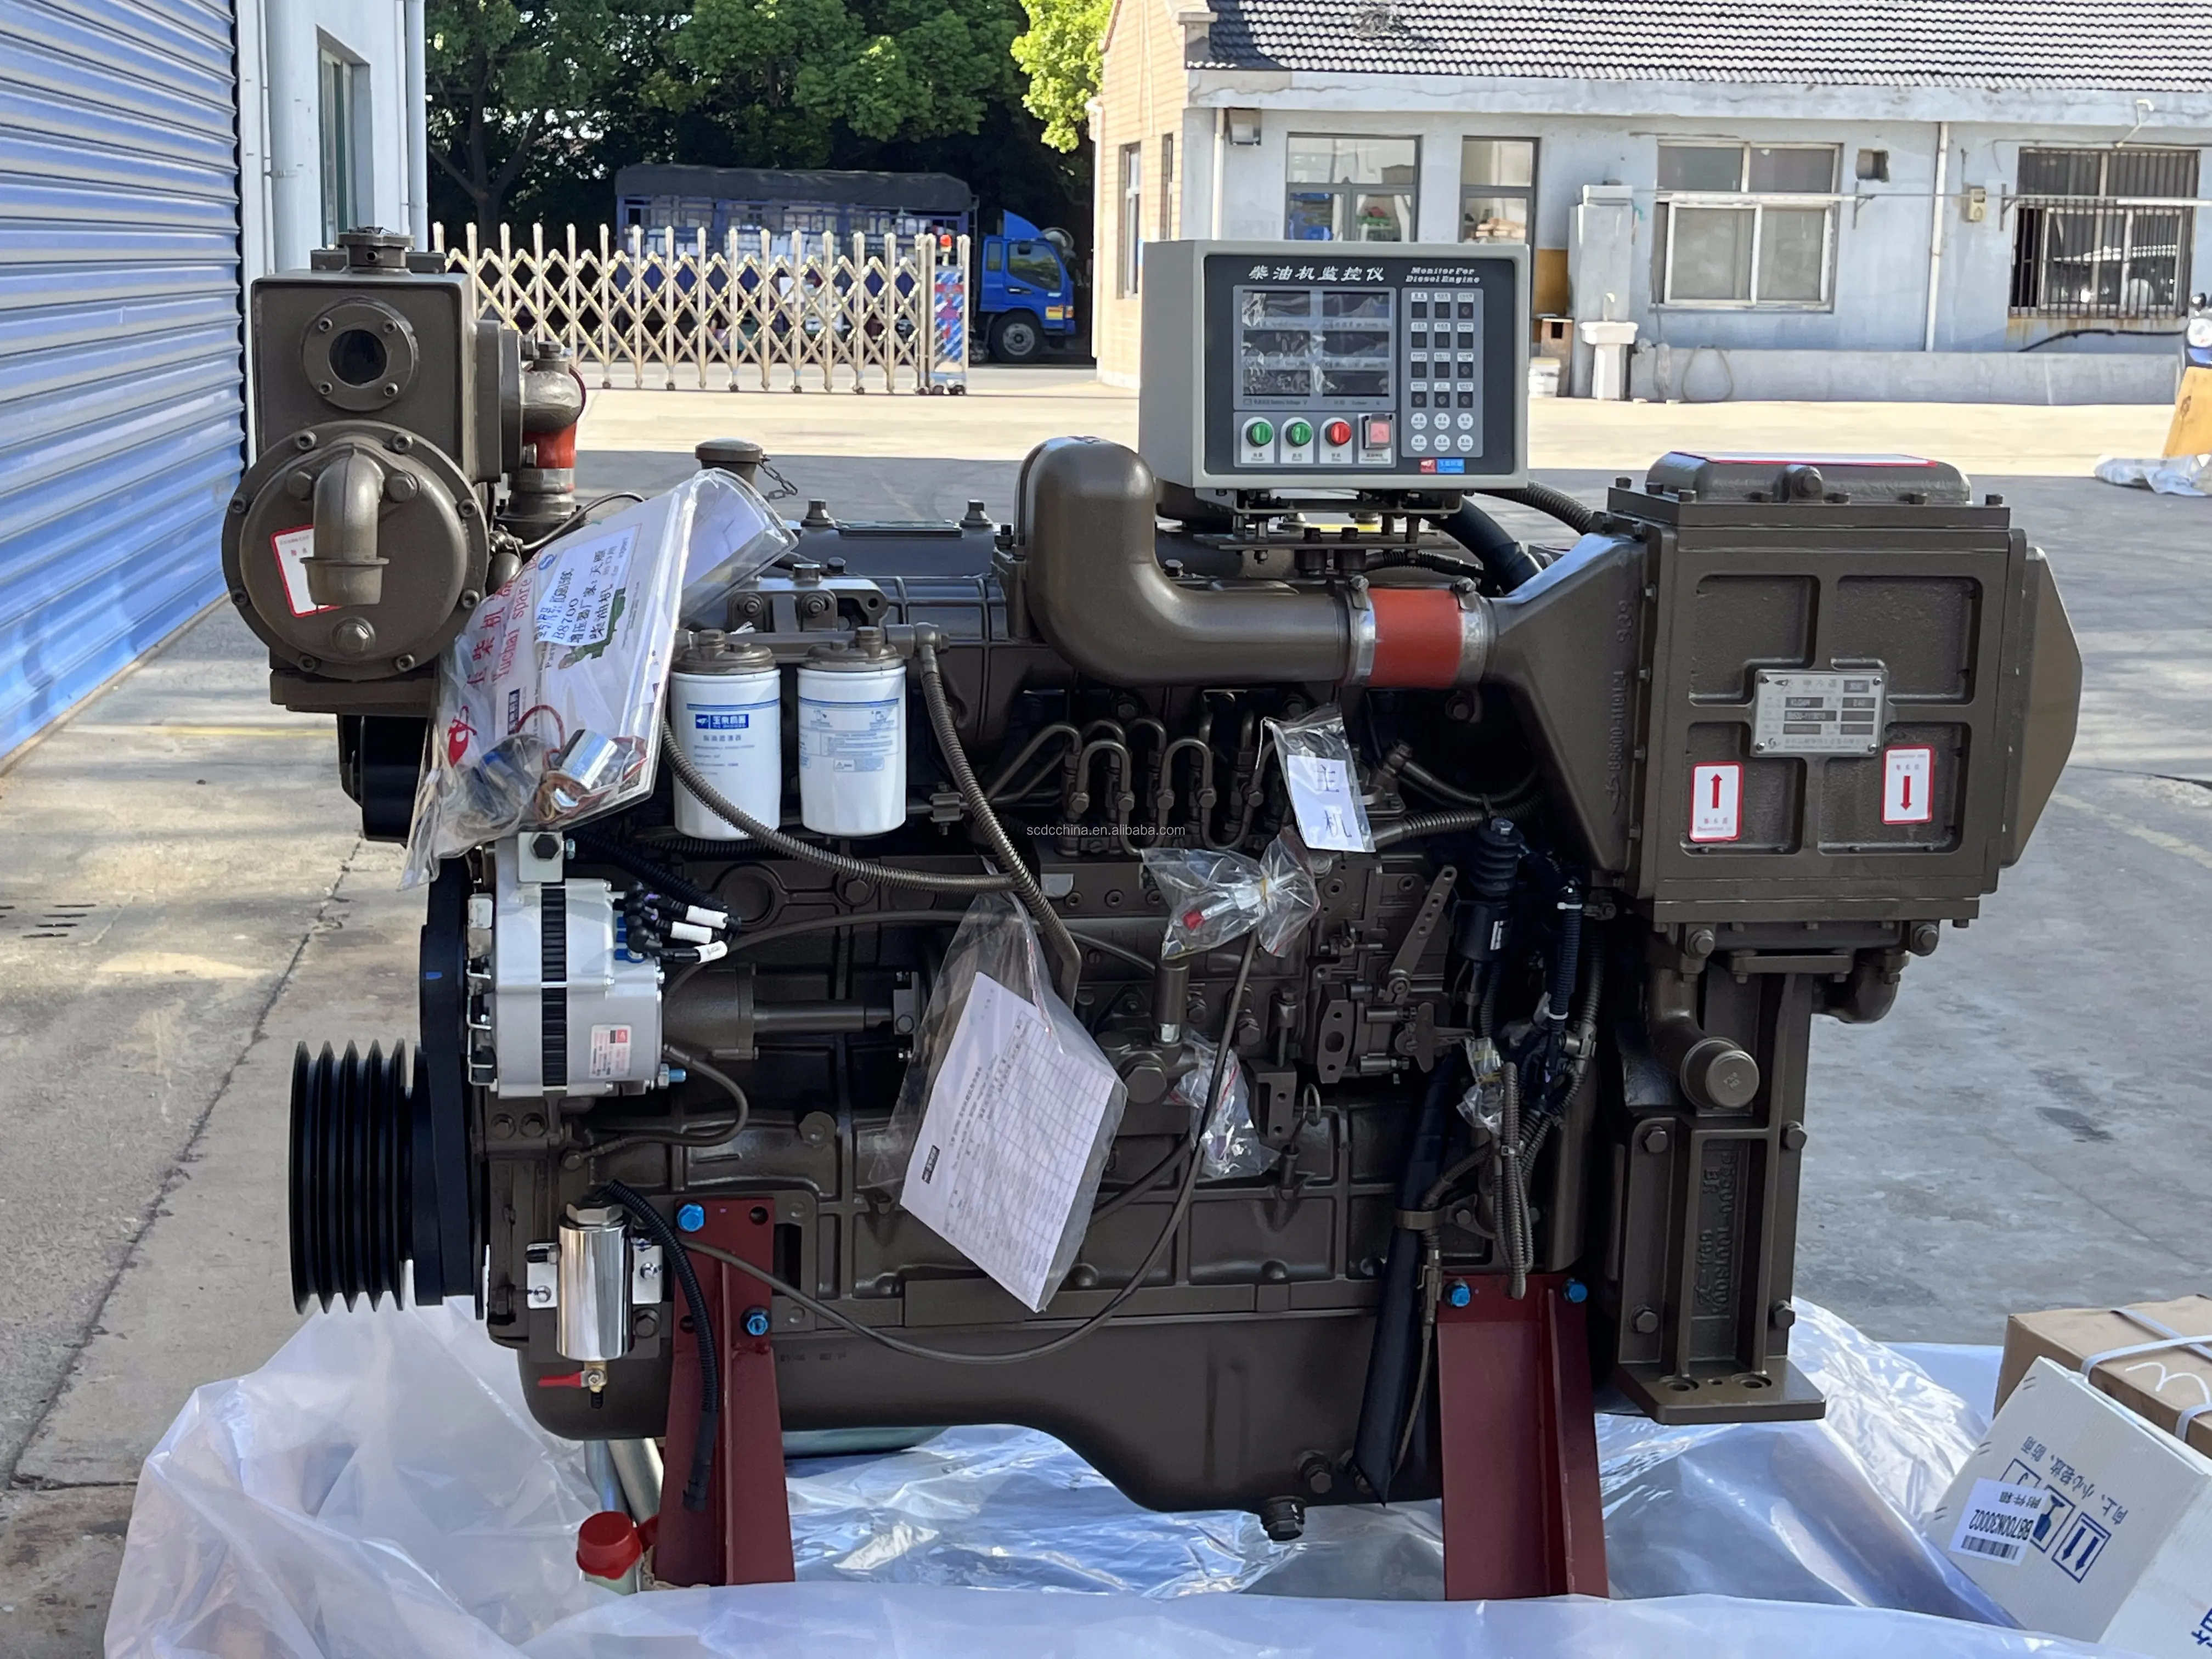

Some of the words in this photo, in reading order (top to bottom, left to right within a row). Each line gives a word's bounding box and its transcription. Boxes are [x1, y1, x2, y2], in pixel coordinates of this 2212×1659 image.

[1249, 266, 1385, 281] 柴油机监控仪
[1442, 275, 1480, 284] Engine
[552, 599, 579, 640] B8700
[492, 627, 520, 682] Yuchai
[512, 577, 533, 620] spare
[1999, 1491, 2042, 1509] 附件箱
